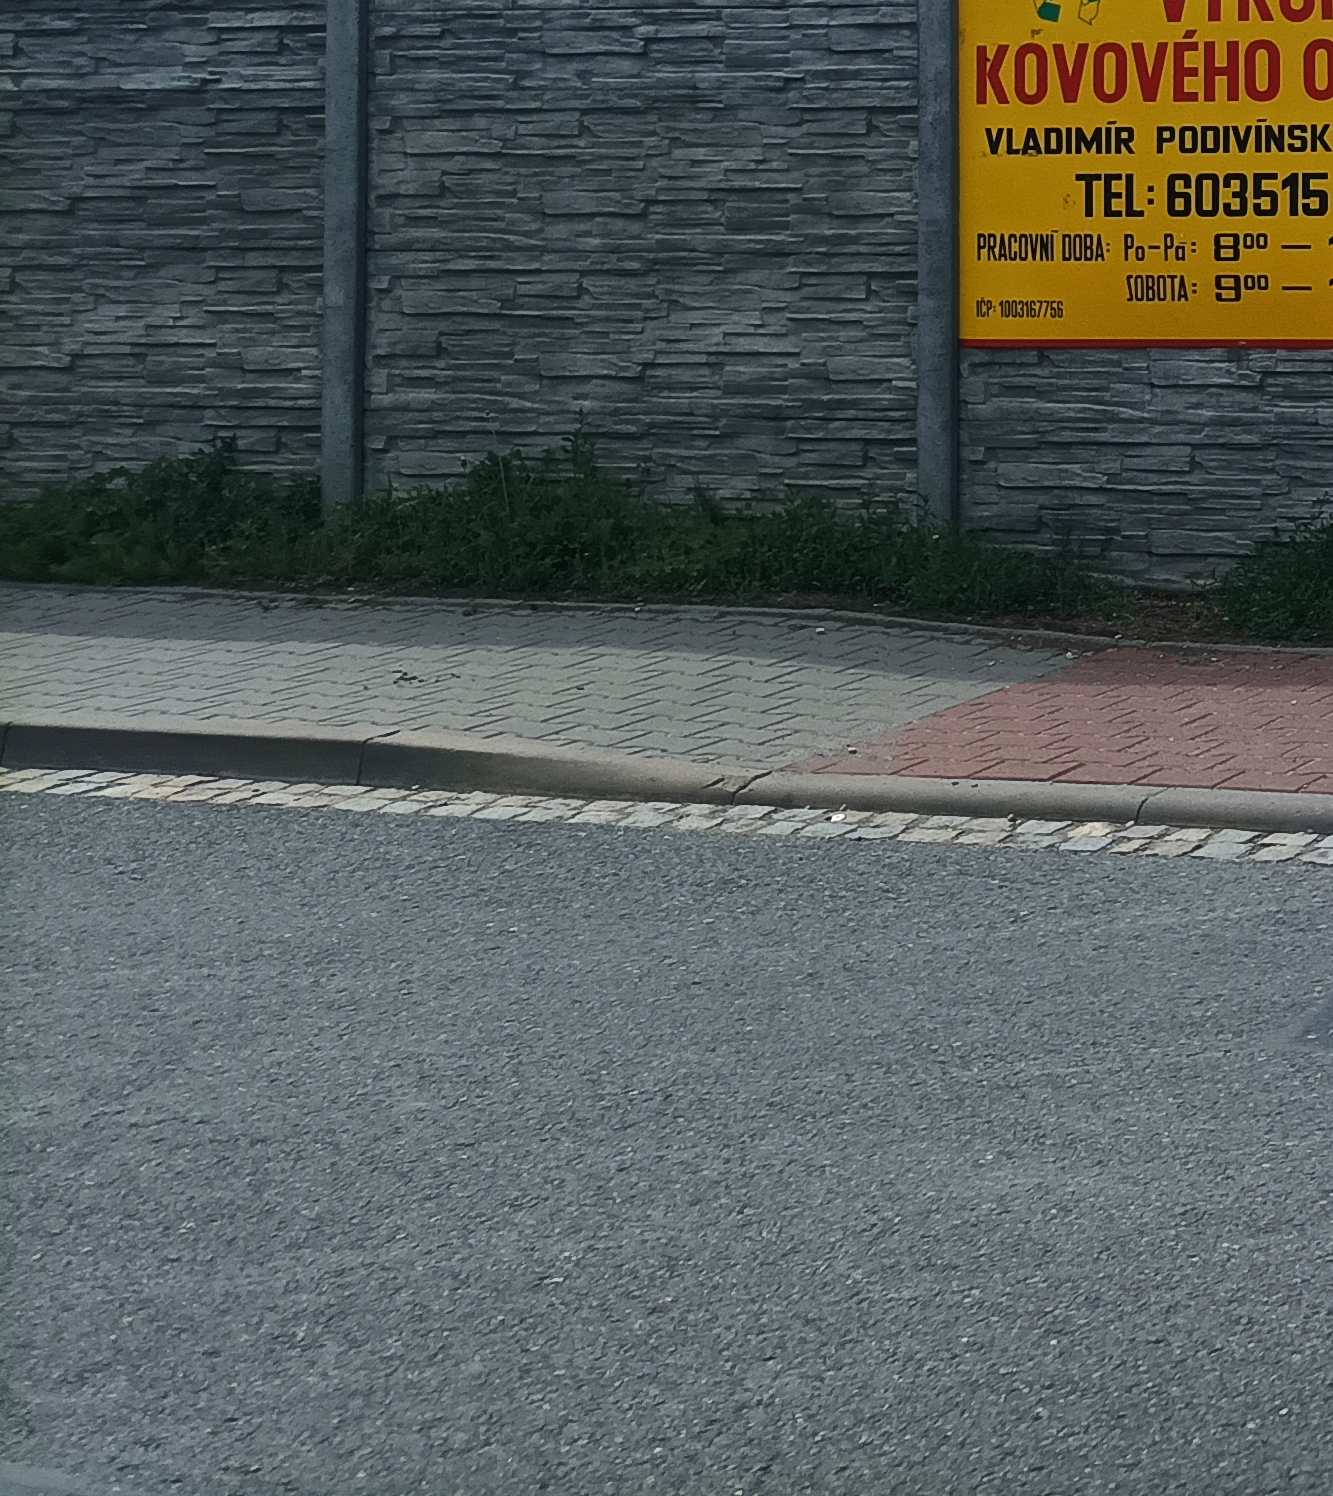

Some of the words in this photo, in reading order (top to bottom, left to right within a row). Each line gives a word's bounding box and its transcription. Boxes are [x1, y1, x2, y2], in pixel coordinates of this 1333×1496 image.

[976, 29, 1281, 105] KOVOVÉHO
[985, 120, 1136, 155] VLADIMÍR
[1075, 173, 1155, 218] TEL:
[976, 229, 1059, 262] PRACOVNÍ
[1061, 233, 1111, 262] DOBA:
[1126, 274, 1198, 302] SOBOTA:
[999, 300, 1064, 319] 1003167756
